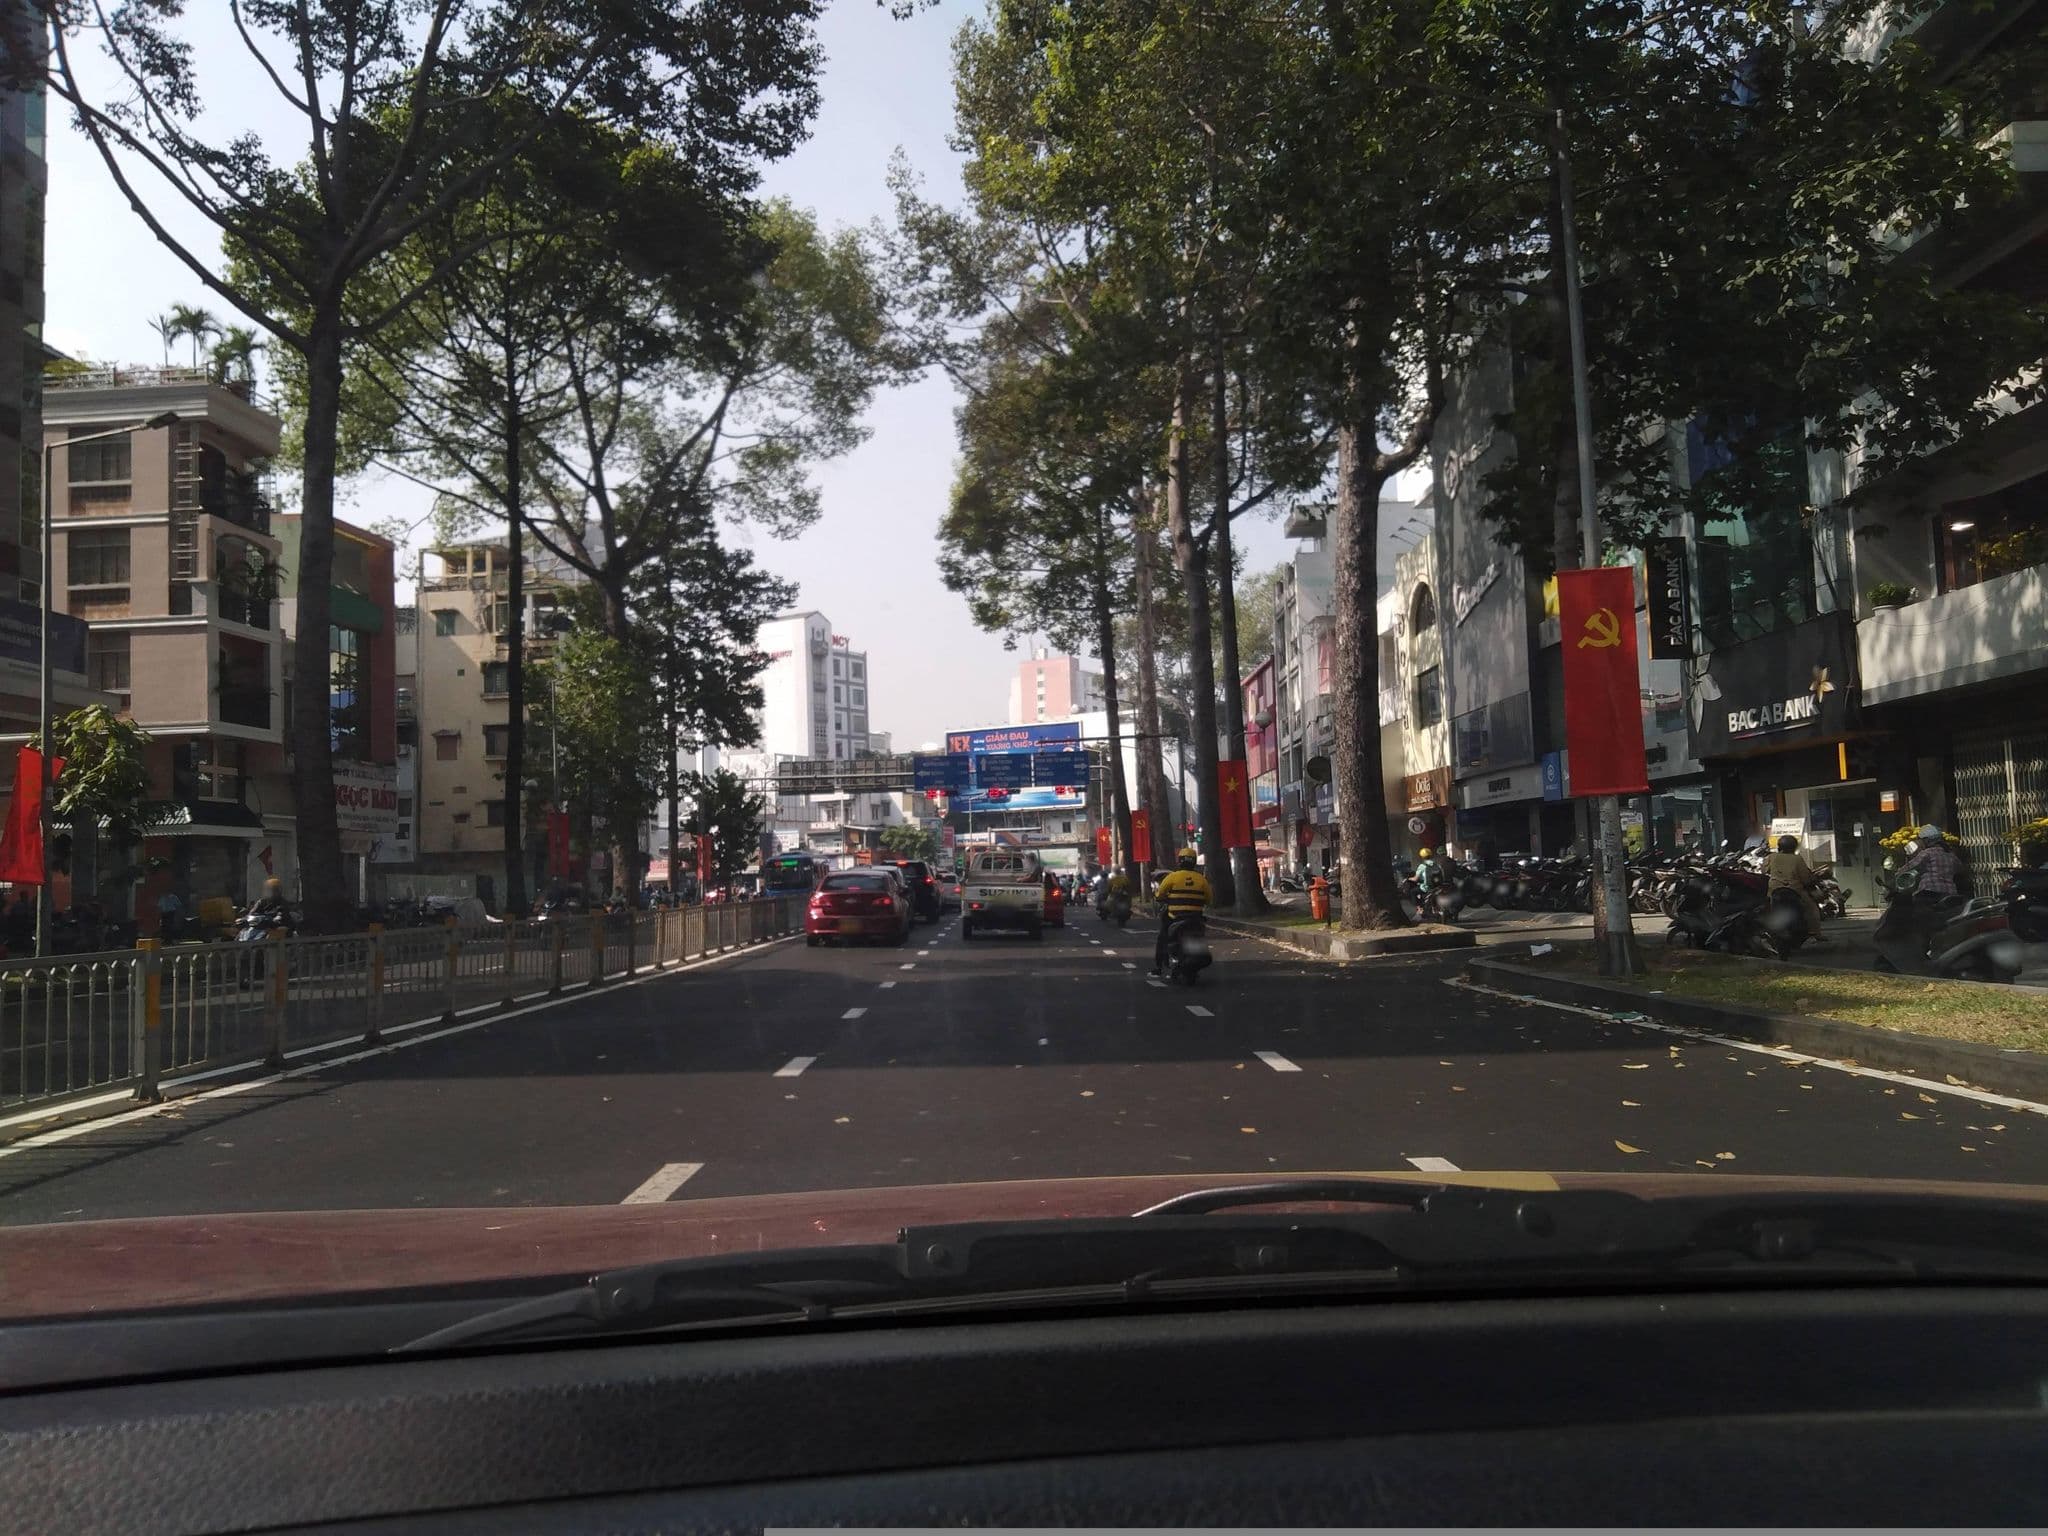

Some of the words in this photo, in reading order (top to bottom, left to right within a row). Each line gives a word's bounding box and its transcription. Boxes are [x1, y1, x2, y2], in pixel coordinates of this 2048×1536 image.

[1666, 557, 1680, 598] BANK
[1728, 708, 1760, 733] BAC
[1760, 705, 1772, 727] A
[1772, 694, 1821, 724] BANK
[979, 888, 1028, 897] SUZUKI
